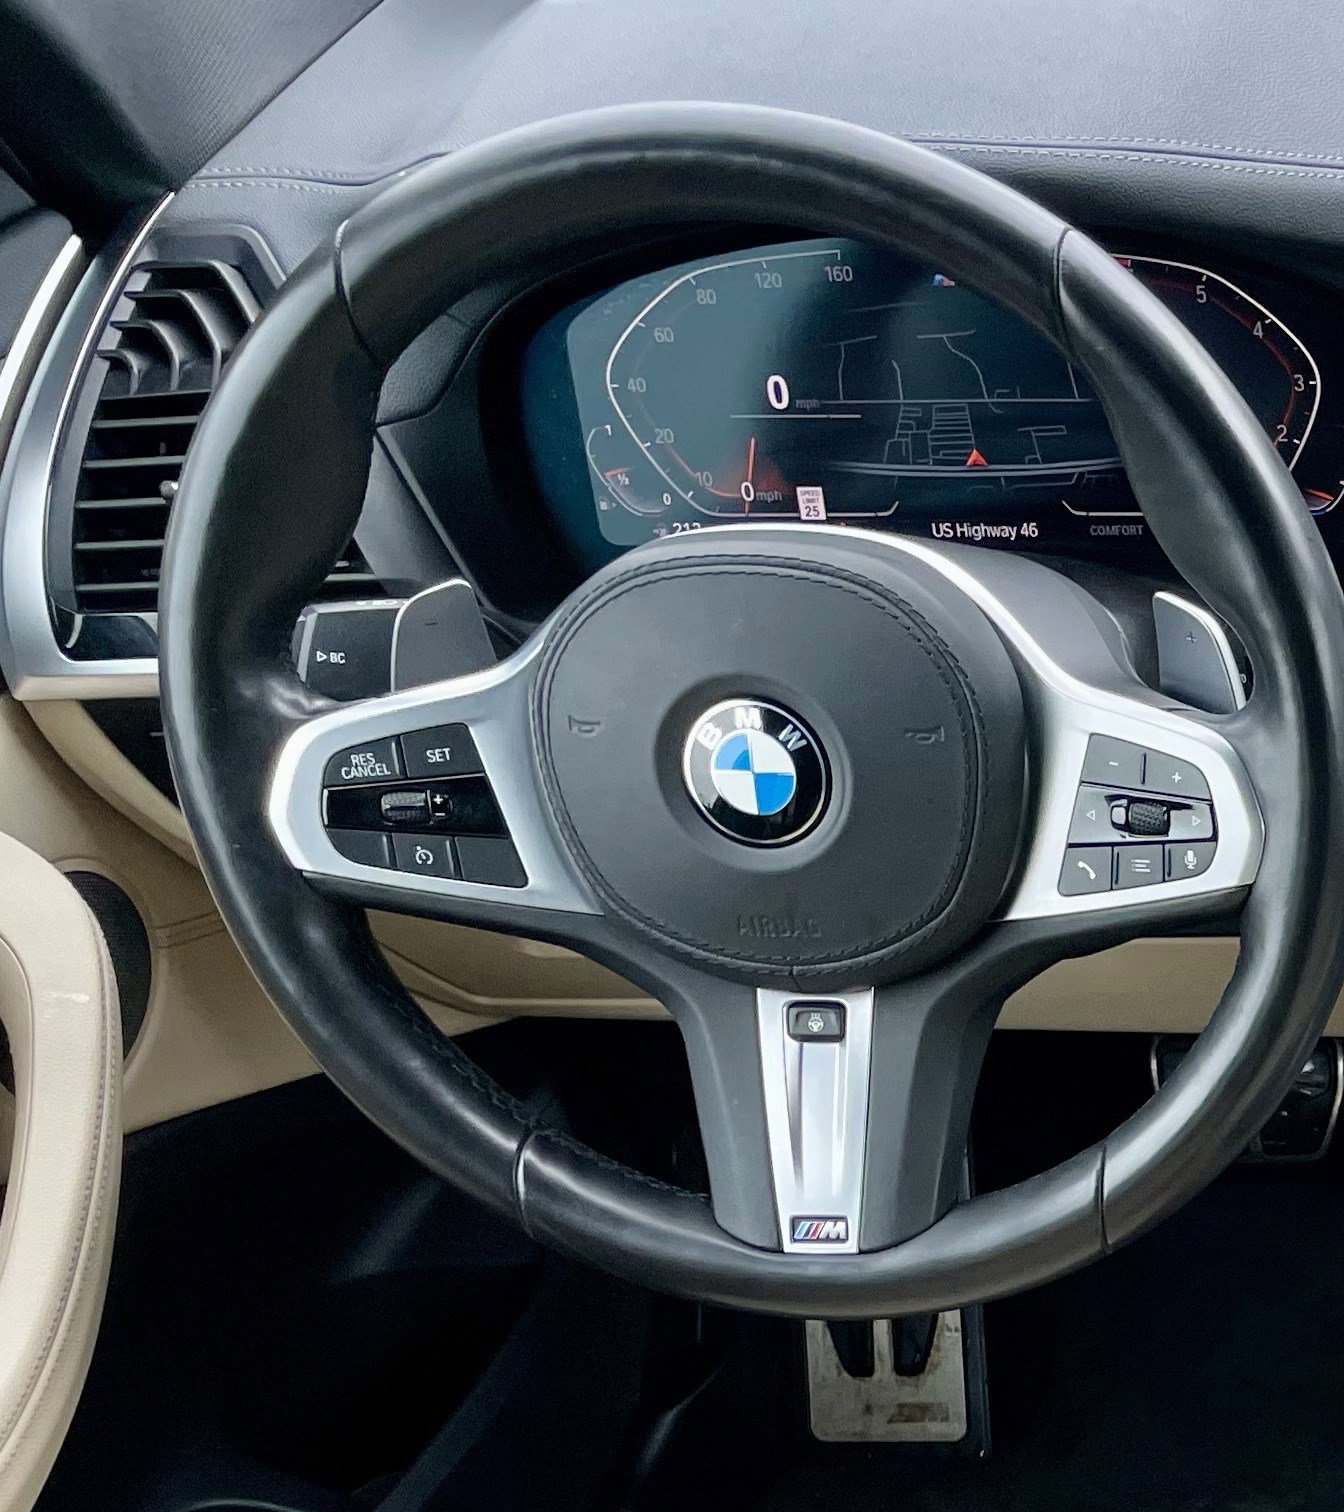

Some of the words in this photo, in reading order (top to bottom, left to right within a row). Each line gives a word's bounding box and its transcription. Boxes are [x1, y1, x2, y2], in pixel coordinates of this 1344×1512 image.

[754, 272, 783, 289] 120
[823, 265, 853, 283] 160
[696, 288, 717, 305] 80
[1196, 285, 1207, 304] 5
[653, 327, 675, 344] 60
[1252, 321, 1264, 339] 4
[627, 377, 647, 393] 40
[1294, 374, 1305, 392] 3
[766, 373, 790, 411] 0
[655, 428, 675, 444] 20
[1276, 424, 1289, 442] 2
[696, 471, 714, 488] 10
[662, 492, 672, 505] 0
[741, 481, 755, 502] 0
[756, 490, 783, 503] mph
[805, 505, 820, 518] 25
[931, 522, 954, 538] US
[956, 522, 1017, 541] Highway
[1020, 522, 1039, 538] 46
[1090, 524, 1144, 536] COMFORT
[329, 651, 346, 664] BC
[695, 706, 808, 752] BMW
[350, 752, 376, 767] RES
[426, 746, 452, 764] SET
[341, 763, 392, 779] CANCEL
